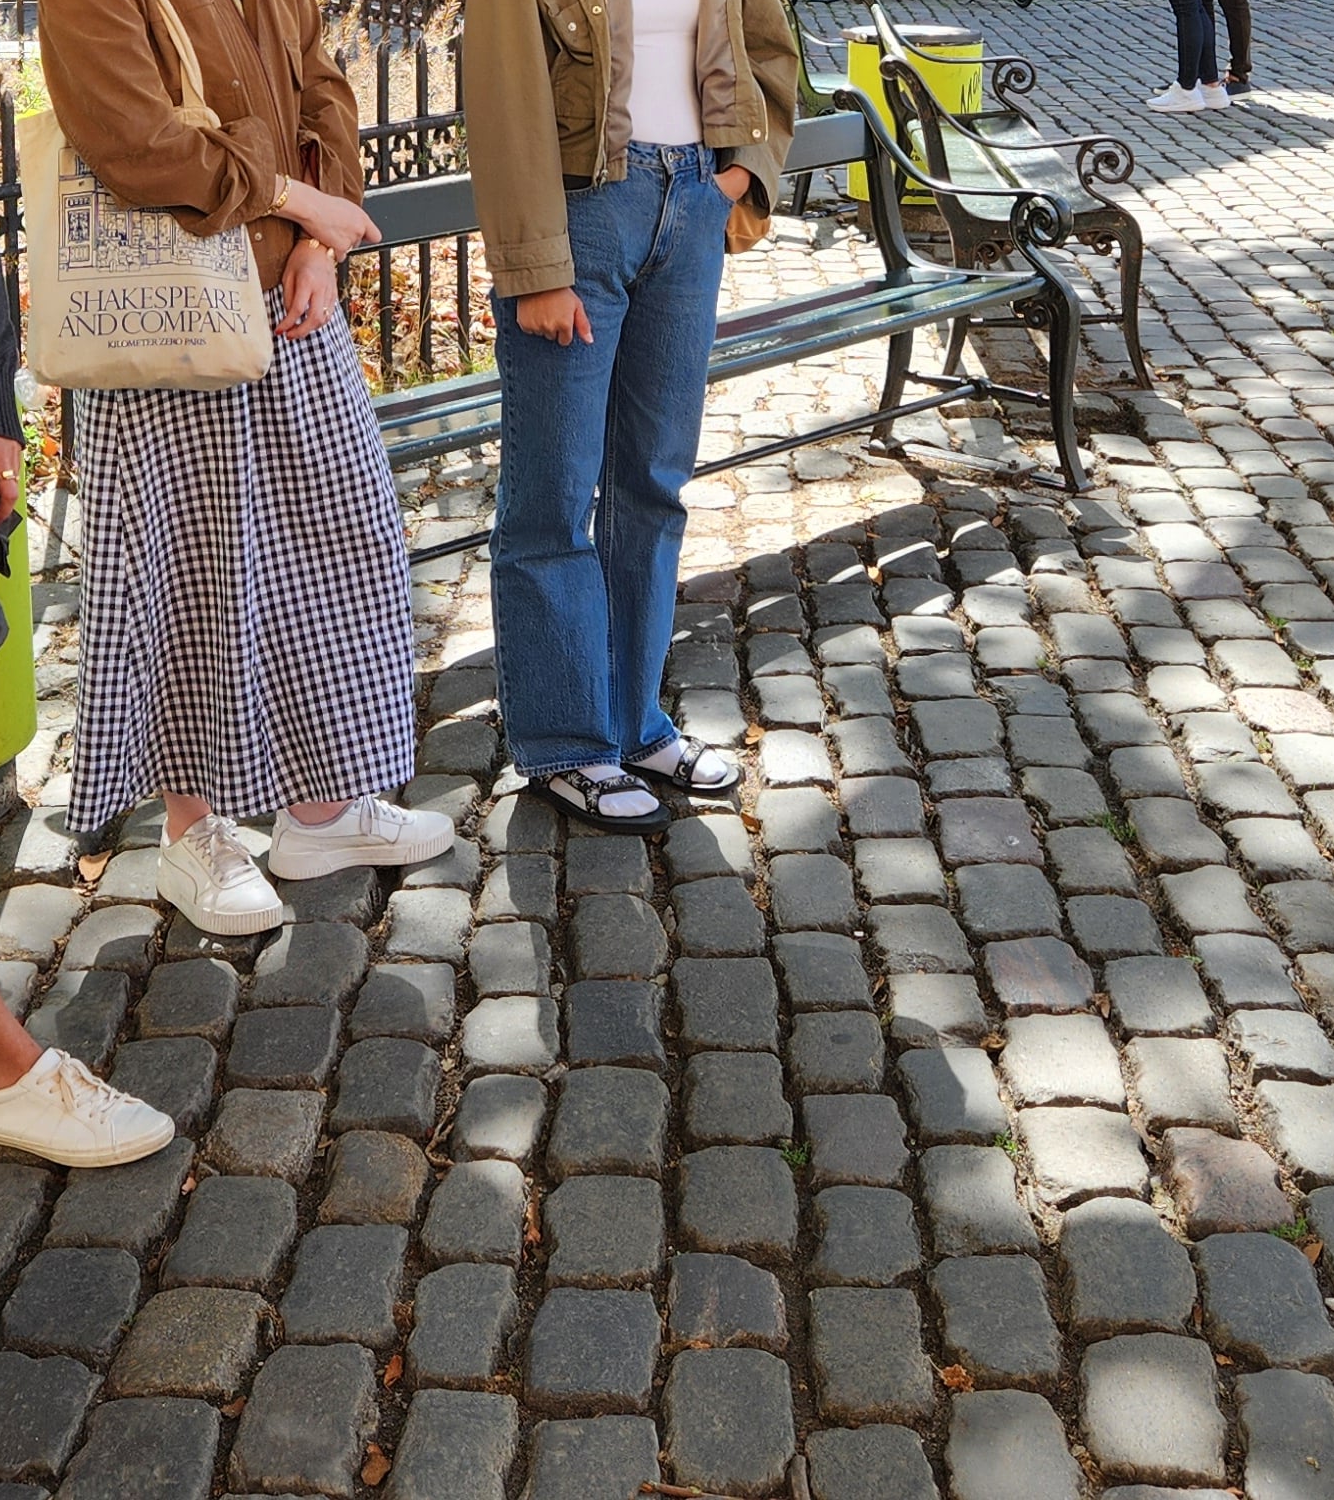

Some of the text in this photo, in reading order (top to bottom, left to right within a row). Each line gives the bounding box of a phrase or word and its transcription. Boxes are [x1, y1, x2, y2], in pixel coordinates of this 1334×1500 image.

[68, 285, 243, 314] SHAKESPEARE
[58, 309, 252, 338] AND COMPANY
[107, 338, 207, 349] KILOMETER ZERO PARIS
